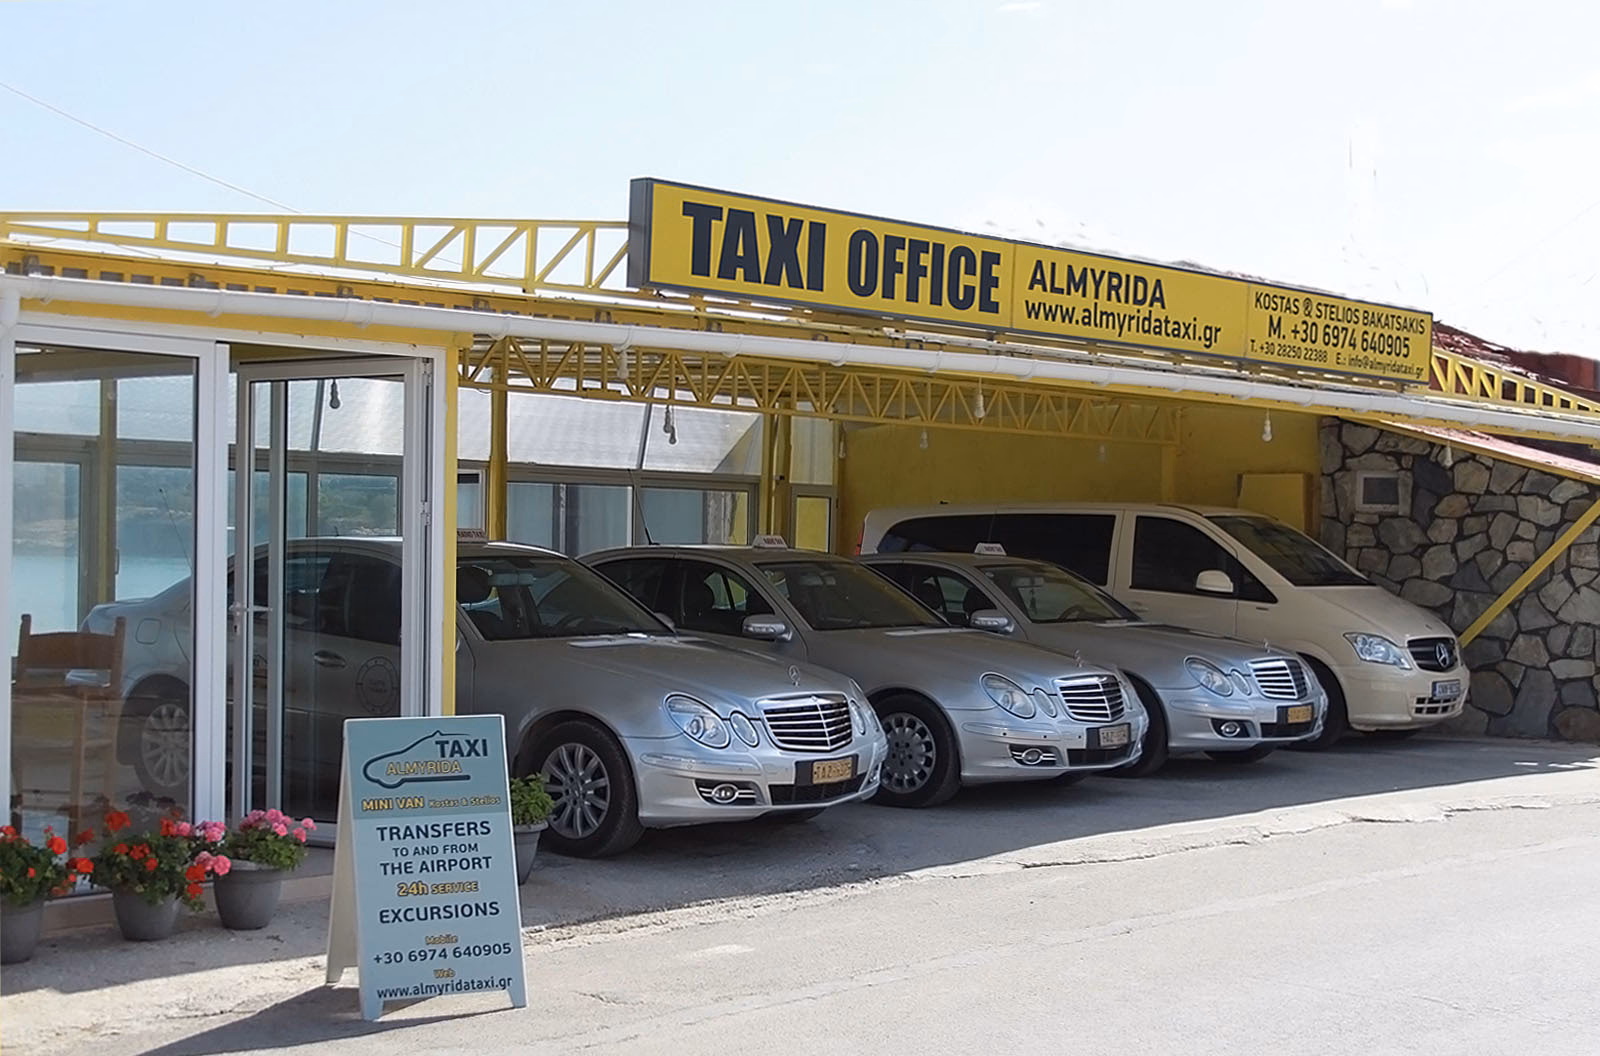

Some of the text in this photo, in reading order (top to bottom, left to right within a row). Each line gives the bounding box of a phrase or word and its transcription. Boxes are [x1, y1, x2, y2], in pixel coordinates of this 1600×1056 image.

[682, 200, 1001, 314] TAXI OFFICE
[1027, 259, 1166, 309] ALMYRIDA
[1254, 291, 1300, 315] KOSTAS
[1315, 302, 1360, 325] STELIOS
[1362, 310, 1426, 335] BAKATSAKIS
[1024, 299, 1221, 350] www.almyridataxi.gr
[1268, 315, 1410, 359] M. +30 6974 640905
[1260, 341, 1274, 356] +30
[435, 738, 488, 759] TAXI
[386, 760, 462, 776] ALMYRIDA
[362, 798, 393, 812] MINI
[396, 796, 425, 810] VAN
[429, 798, 459, 809] Kostas
[376, 820, 491, 842] TRANSFERS
[393, 842, 479, 858] TO AND FROM
[380, 856, 492, 877] THE AIRPORT
[397, 881, 479, 897] 24h SERVICE
[379, 901, 500, 924] EXCURSIONS
[425, 934, 459, 946] Mobile
[373, 942, 512, 965] +30 6974 640905
[434, 968, 456, 979] Web
[376, 974, 513, 999] www.almyridataxi.gr
